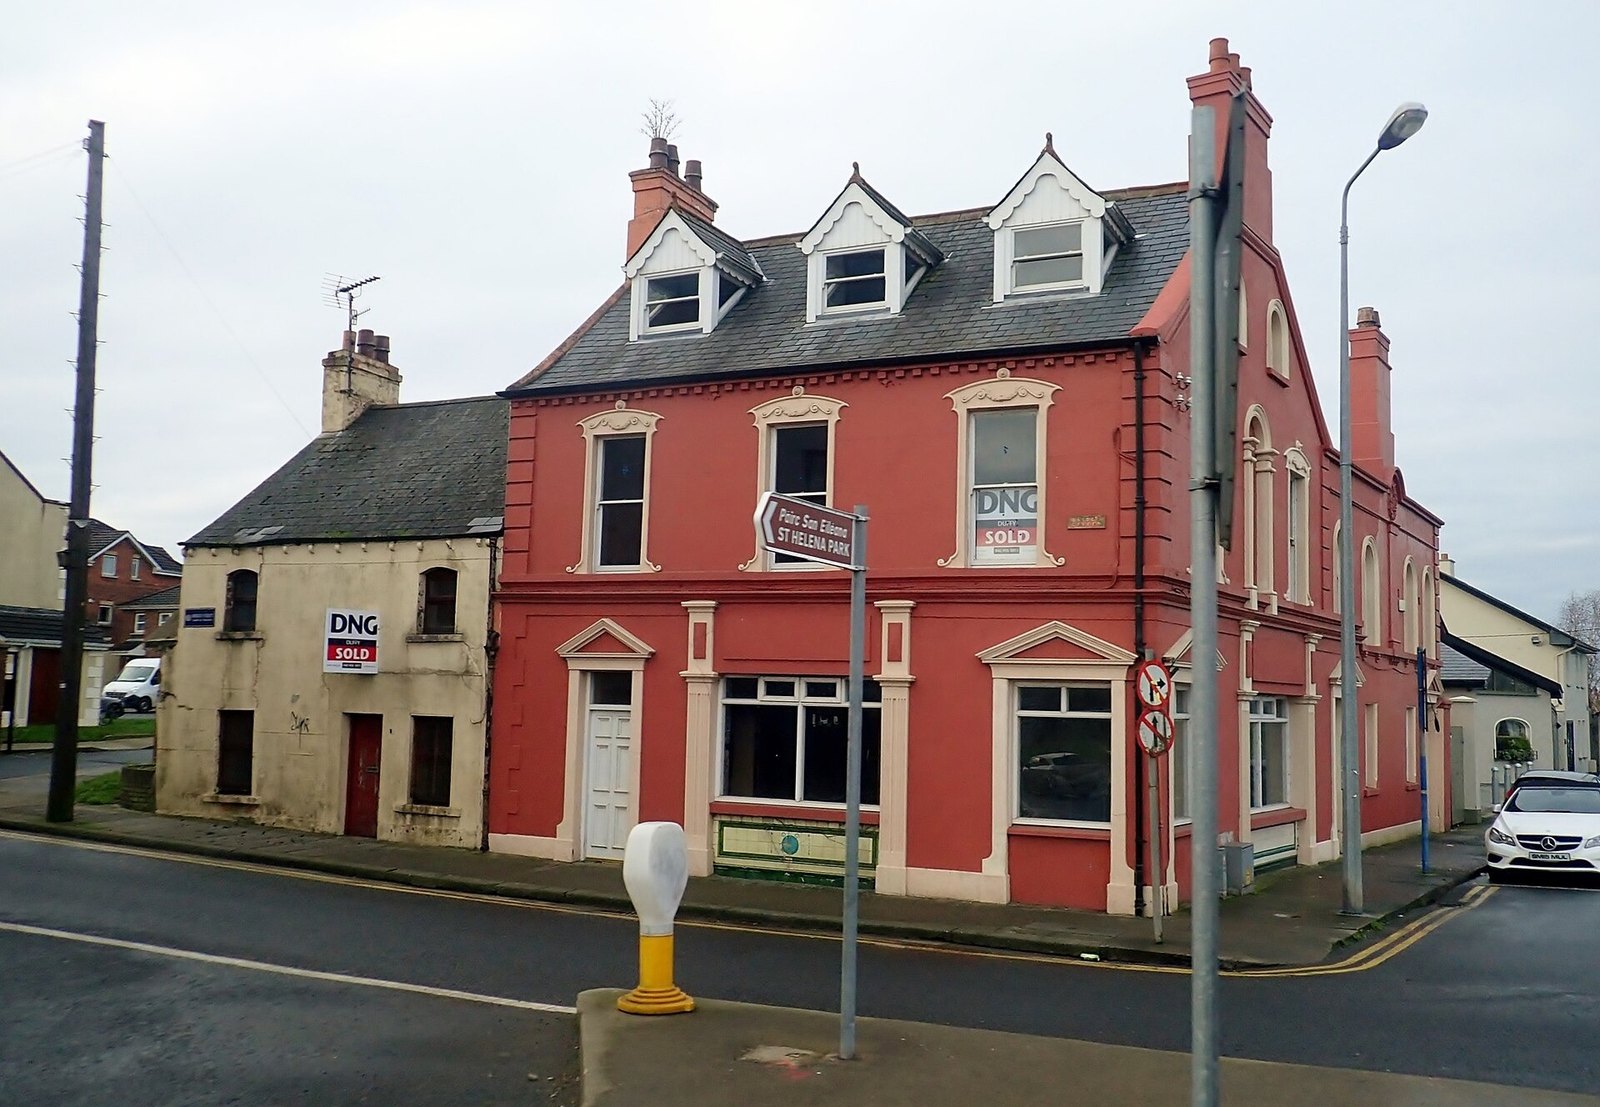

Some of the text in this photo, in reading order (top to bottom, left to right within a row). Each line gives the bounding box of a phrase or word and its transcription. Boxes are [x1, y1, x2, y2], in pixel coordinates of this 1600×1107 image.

[978, 490, 1037, 514] DNG
[802, 514, 818, 530] San
[777, 526, 850, 557] ST HELENA PARK
[985, 530, 1031, 544] SOLD
[331, 613, 378, 635] DNG
[335, 647, 370, 660] SOLD
